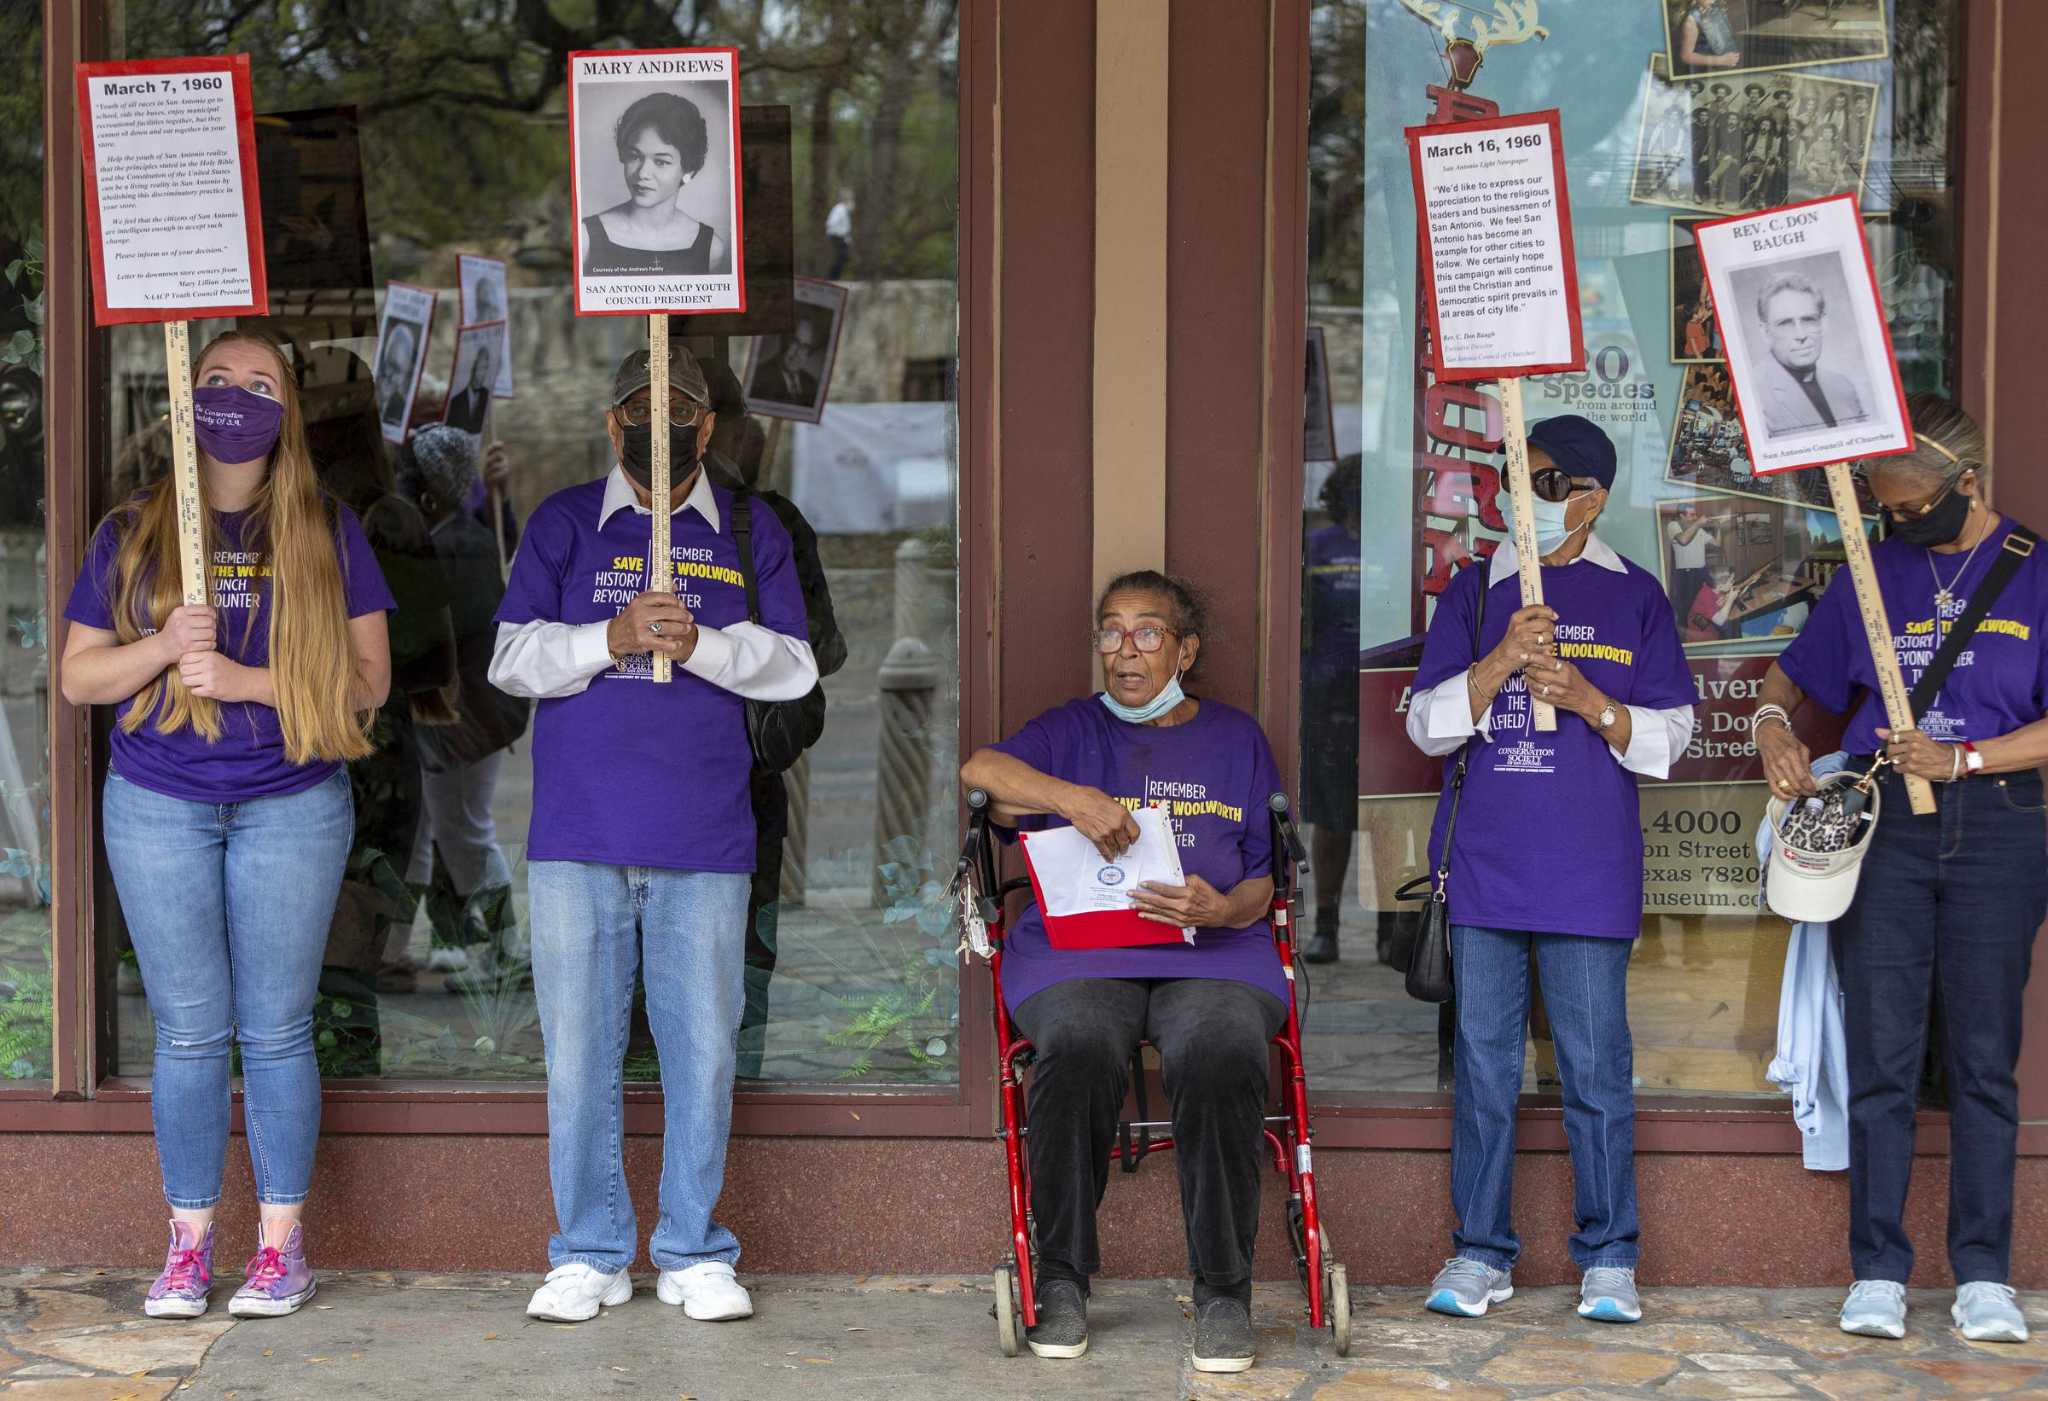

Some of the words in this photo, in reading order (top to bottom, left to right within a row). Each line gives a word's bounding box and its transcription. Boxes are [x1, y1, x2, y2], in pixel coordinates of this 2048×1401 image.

[584, 62, 632, 75] MARY
[638, 60, 724, 74] ANDREWS
[104, 81, 155, 95] March
[161, 80, 176, 93] 7,
[182, 77, 222, 90] 1960
[1426, 142, 1472, 157] March
[1477, 139, 1500, 152] 16,
[1505, 134, 1541, 149] 1960
[1460, 183, 1475, 191] like
[1489, 179, 1524, 188] express
[1428, 195, 1480, 208] appreciation
[1510, 188, 1549, 198] religious
[1429, 210, 1459, 219] leaders
[1461, 207, 1478, 215] and
[1480, 202, 1539, 213] businessmen
[1542, 199, 1551, 207] of
[1505, 215, 1521, 224] feel
[1733, 222, 1766, 239] REV.
[1769, 218, 1783, 233] C.
[1787, 212, 1819, 230] DON
[1433, 234, 1464, 243] Antonio
[1485, 230, 1519, 238] become
[1752, 233, 1805, 252] BAUGH
[1434, 246, 1467, 256] example
[1484, 243, 1507, 251] other
[1509, 240, 1533, 248] cities
[1482, 254, 1519, 264] certainly
[1522, 252, 1544, 261] hope
[1454, 269, 1495, 279] campaign
[1497, 267, 1512, 275] will
[1514, 264, 1553, 273] continue
[586, 286, 606, 294] SAN
[610, 284, 656, 293] ANTONIO
[658, 284, 692, 292] NAACP
[696, 283, 730, 292] YOUTH
[1438, 285, 1456, 293] until
[1472, 280, 1512, 290] Christian
[1514, 278, 1531, 286] and
[605, 296, 651, 305] COUNCIL
[654, 295, 712, 304] PRESIDENT
[1438, 295, 1485, 305] democratic
[1487, 292, 1509, 302] spirit
[1511, 289, 1546, 301] prevails
[1487, 306, 1504, 315] city
[1544, 382, 1654, 404] Species
[1576, 400, 1607, 410] from
[1611, 400, 1656, 410] around
[1610, 412, 1647, 422] world
[595, 572, 642, 587] HISTORY
[613, 556, 644, 571] SAVE
[677, 564, 744, 588] WOOLWORT
[216, 579, 246, 591] UNCH
[214, 593, 260, 608] OUNTER
[1905, 618, 1935, 634] SAVE
[1560, 643, 1633, 666] WOOLWORTH
[1897, 651, 1933, 666] EYOND
[1508, 696, 1526, 710] THE
[1498, 748, 1554, 756] CONSERVATION
[1150, 781, 1206, 799] REMEMBER
[1173, 800, 1242, 822] WOOLWORTH
[1643, 810, 1741, 834] .4000
[1644, 844, 1670, 858] on
[1679, 841, 1750, 858] Street
[1642, 868, 1691, 882] exas
[1702, 867, 1759, 882] 7820
